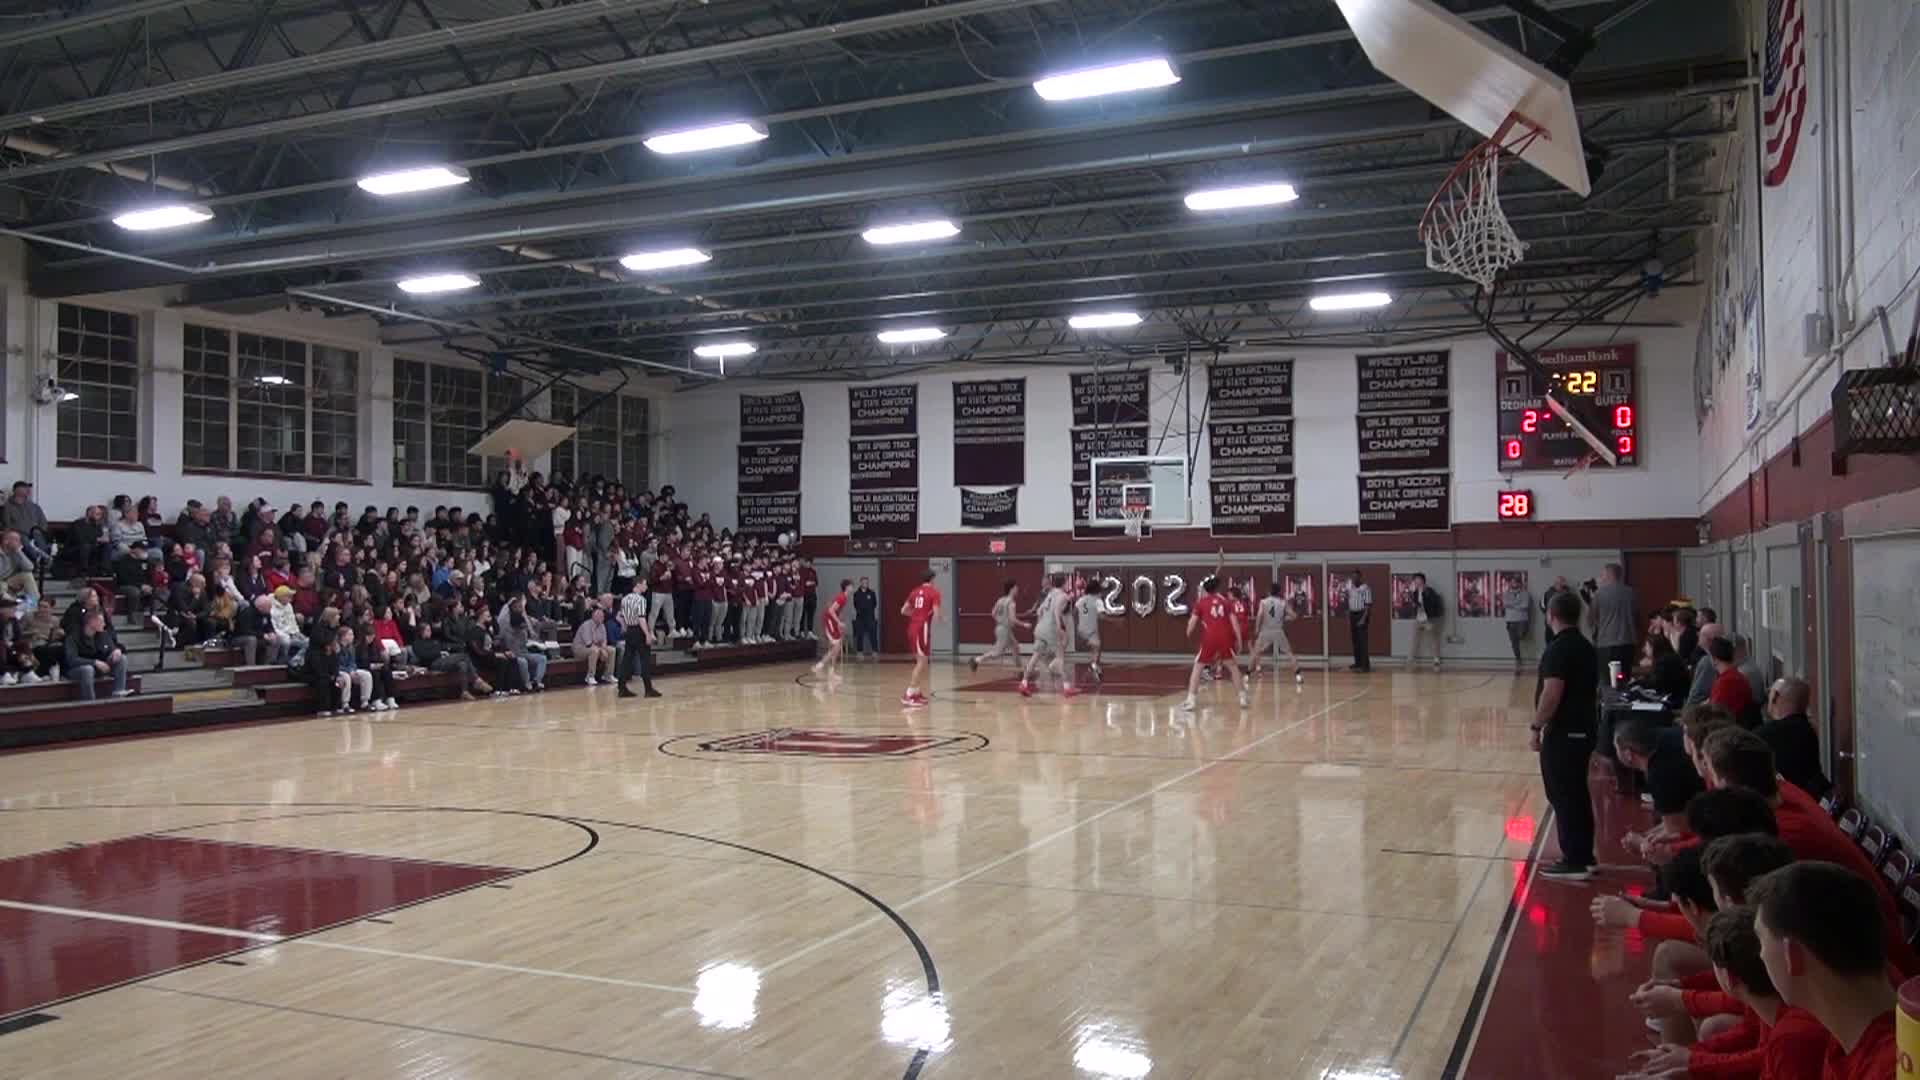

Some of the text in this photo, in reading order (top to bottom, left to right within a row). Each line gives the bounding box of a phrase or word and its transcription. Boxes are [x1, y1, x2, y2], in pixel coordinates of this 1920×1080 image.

[1368, 354, 1439, 367] WRESTLING
[1235, 364, 1289, 376] BASKETBALL
[1361, 369, 1374, 380] BAY
[1375, 368, 1397, 379] STATE
[1212, 379, 1224, 388] BAY
[1226, 377, 1247, 387] STATE
[1369, 377, 1438, 390] CHAMPIONS
[854, 386, 912, 398] FIELD HOCKEY
[1219, 386, 1282, 398] CHAMPIONS
[1501, 399, 1541, 410] DEDHAM
[1595, 395, 1628, 406] GUEST
[857, 407, 909, 417] CHAMPIONS
[962, 405, 1017, 416] CHAMPIONS
[1616, 406, 1632, 427] 0
[1216, 423, 1287, 434] GIRLS SOCCER
[1366, 417, 1387, 428] GIRLS
[1361, 429, 1374, 440] BAY
[1376, 428, 1399, 439] STATE
[1213, 437, 1225, 446] BAY
[1227, 435, 1247, 445] STATE
[1369, 437, 1439, 450] CHAMPIONS
[757, 447, 781, 455] GOLF
[1220, 445, 1284, 457] CHAMPIONS
[1507, 441, 1521, 458] 0
[745, 465, 794, 474] CHAMPIONS
[858, 460, 910, 470] CHAMPIONS
[1219, 483, 1236, 493] BOYS
[1366, 476, 1441, 489] BOYS SOCCER
[1214, 494, 1226, 504] BAY
[1228, 494, 1249, 503] STATE
[1362, 490, 1375, 501] BAY
[1377, 489, 1400, 500] STATE
[1221, 504, 1285, 515] CHAMPIONS
[1369, 498, 1439, 510] CHAMPIONS
[1500, 494, 1528, 516] 28
[745, 515, 793, 524] CHAMPIONS
[858, 513, 910, 522] CHAMPIONS
[914, 596, 925, 609] 10
[1210, 603, 1225, 618] 44
[1268, 605, 1276, 618] 4
